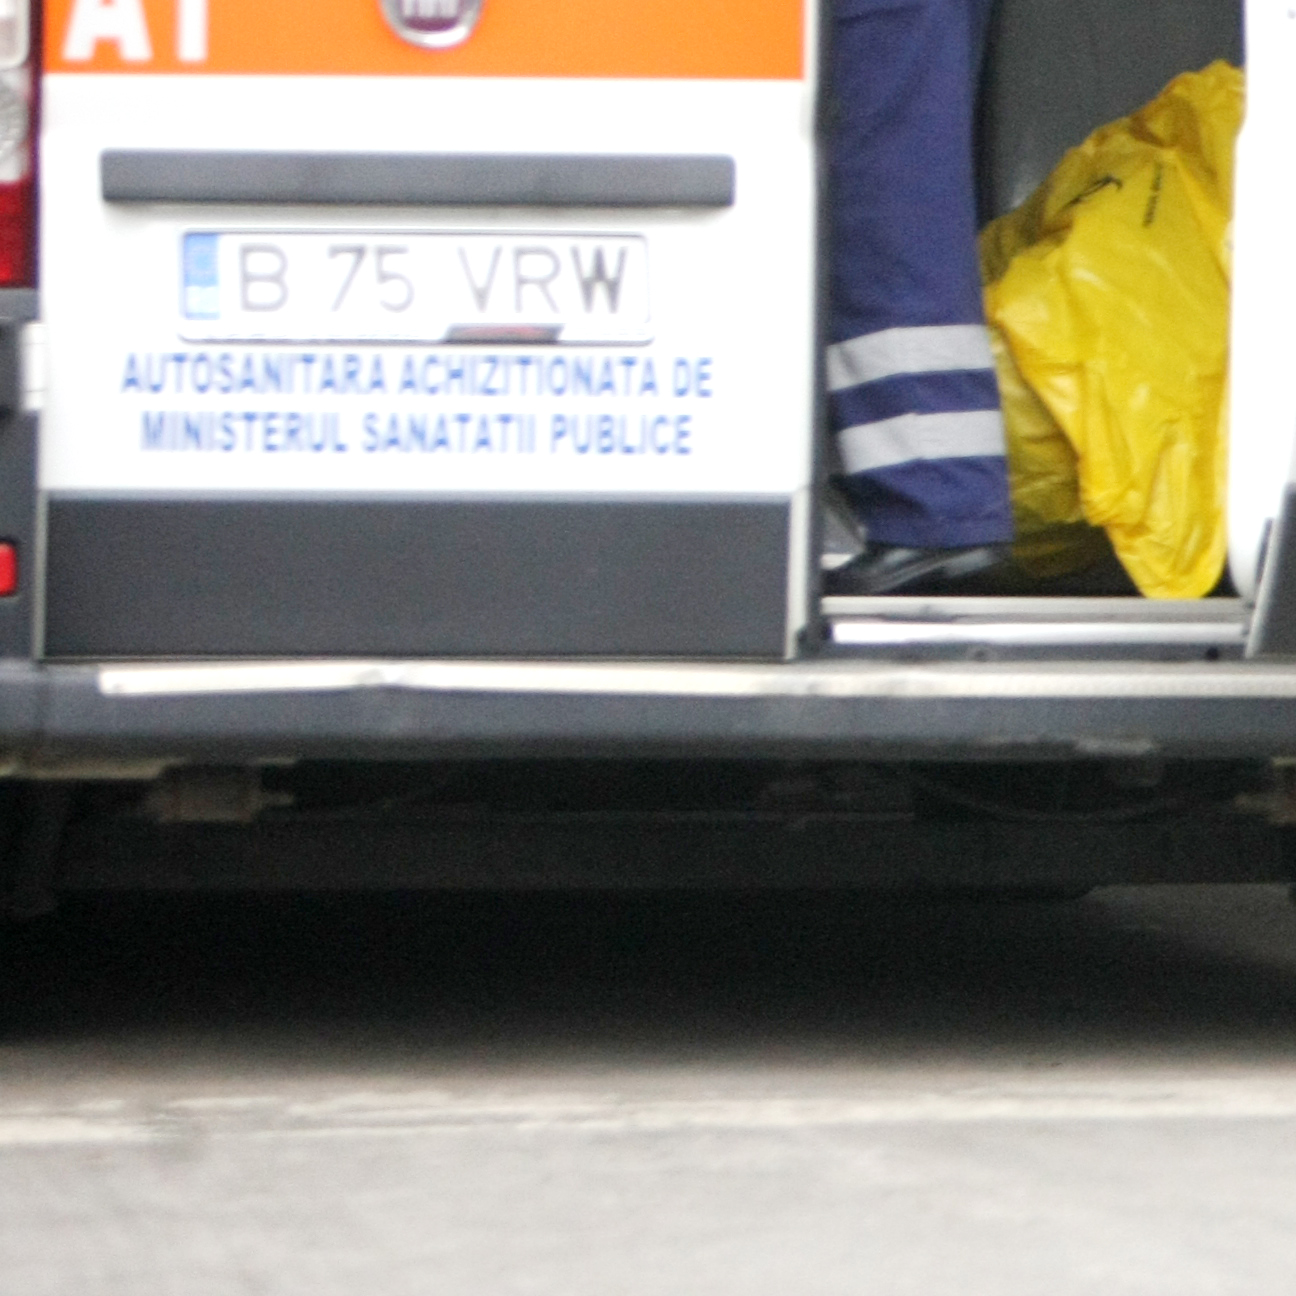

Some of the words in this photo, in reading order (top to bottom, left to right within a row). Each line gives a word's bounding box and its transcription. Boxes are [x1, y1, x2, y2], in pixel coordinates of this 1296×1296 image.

[239, 244, 290, 313] B
[328, 245, 416, 313] 75
[458, 246, 627, 315] VRW
[120, 352, 387, 395] AUTOSANITARA
[399, 354, 660, 397] ACHIZITIONATA
[672, 356, 714, 398] DE
[140, 410, 348, 454] MINISTERUL
[361, 412, 538, 455] SANATATII
[550, 413, 694, 456] PUBLICE
